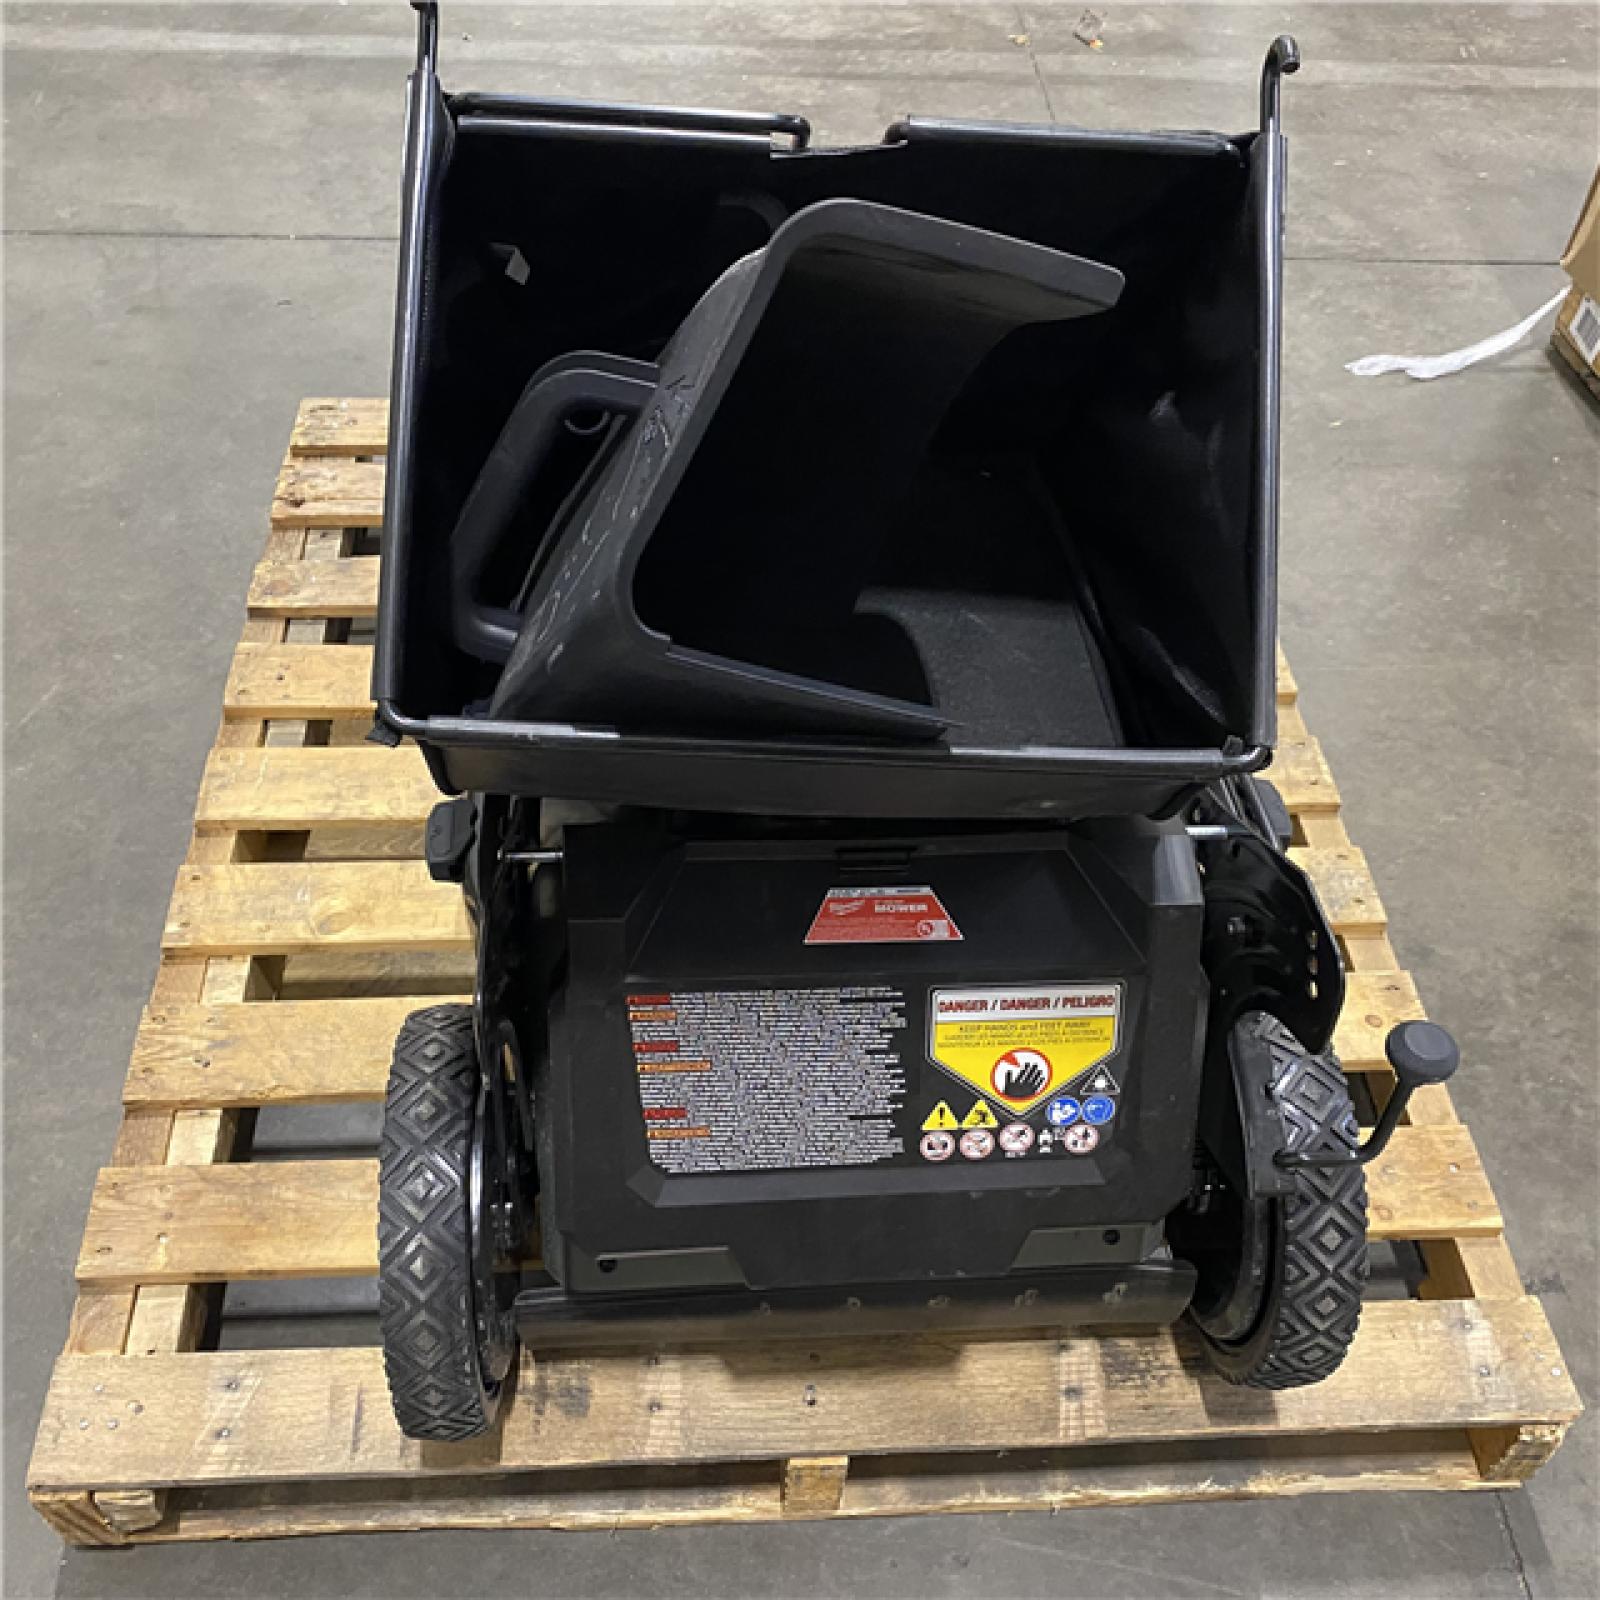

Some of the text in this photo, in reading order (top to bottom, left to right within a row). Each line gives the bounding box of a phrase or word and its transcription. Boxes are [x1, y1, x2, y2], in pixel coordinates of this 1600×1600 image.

[938, 999, 988, 1013] DANGER
[1000, 997, 1051, 1010] DANGER
[1062, 994, 1116, 1008] PELIGRO
